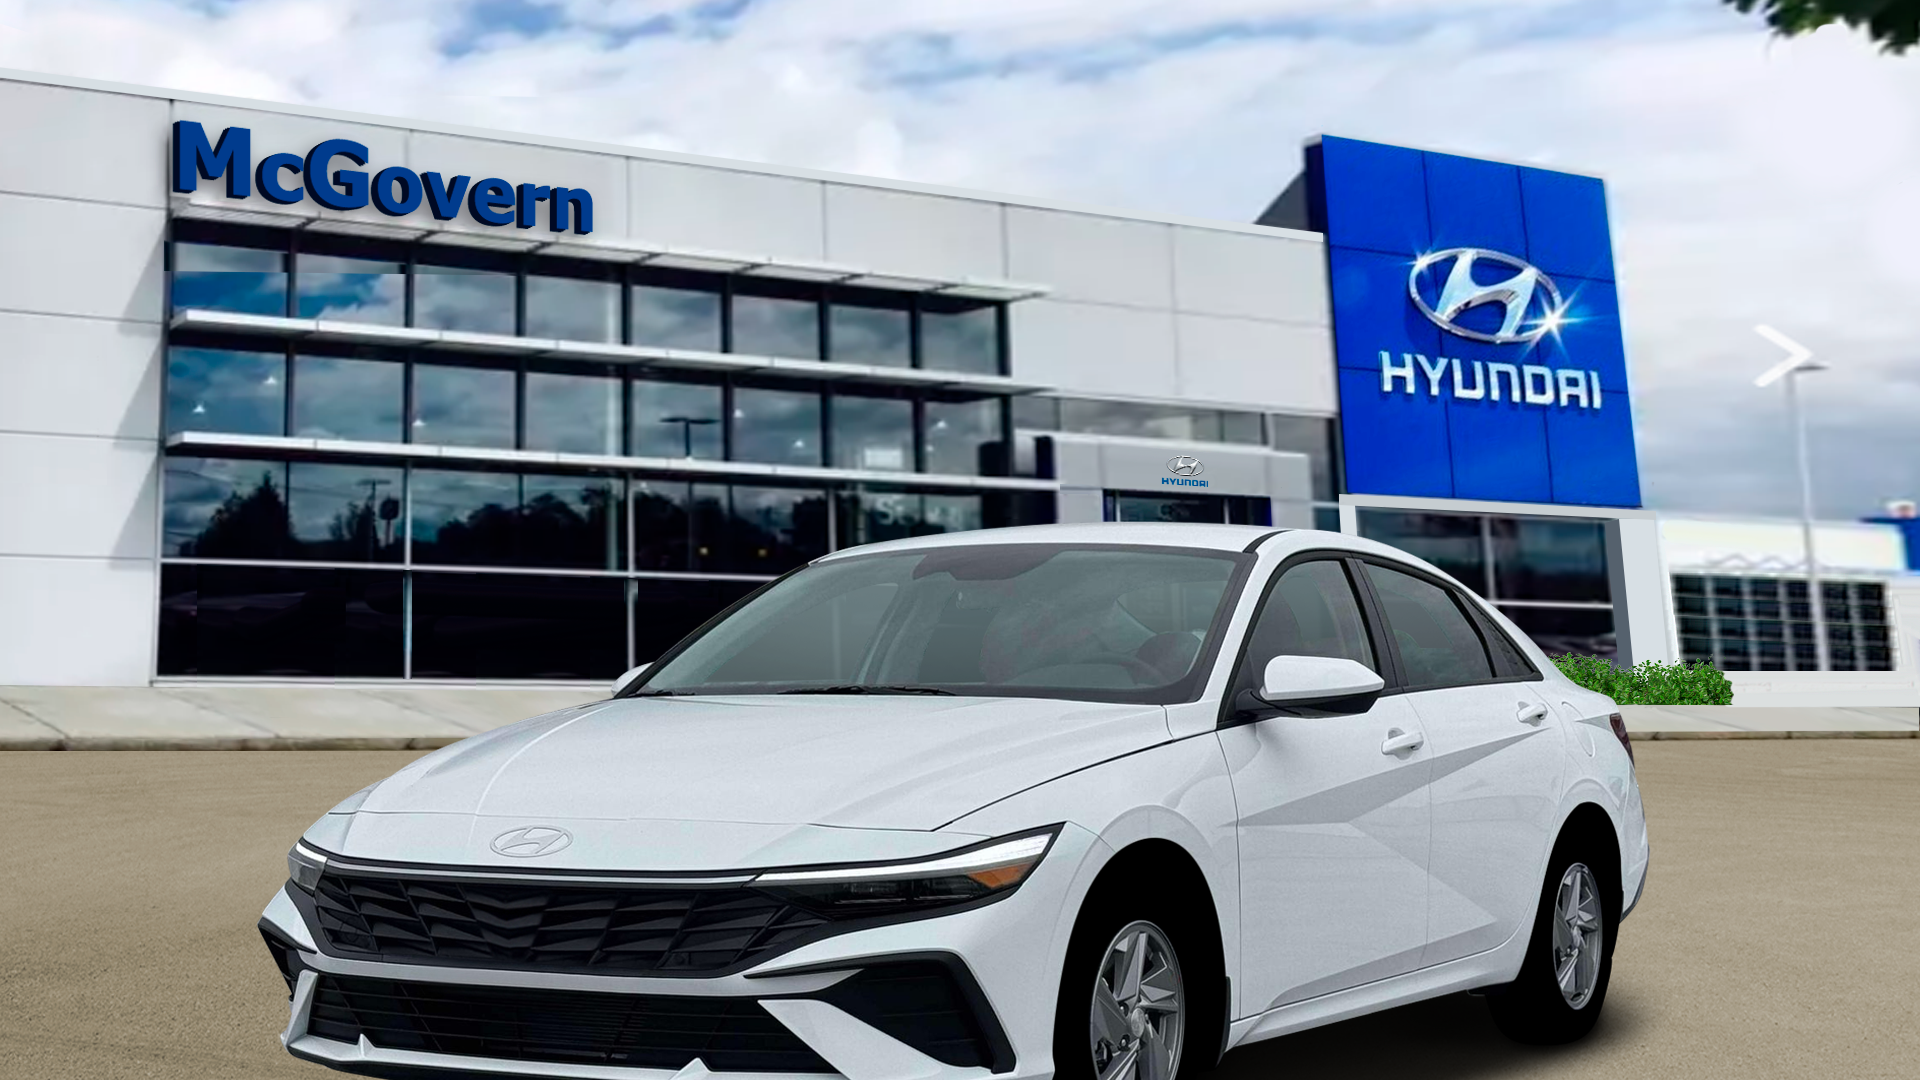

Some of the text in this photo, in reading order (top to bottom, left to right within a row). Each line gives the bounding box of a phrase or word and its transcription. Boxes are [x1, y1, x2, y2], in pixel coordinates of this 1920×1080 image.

[172, 120, 594, 235] McGovern
[1379, 350, 1601, 409] HYUNDAI
[1161, 477, 1209, 488] HYUNDAI
